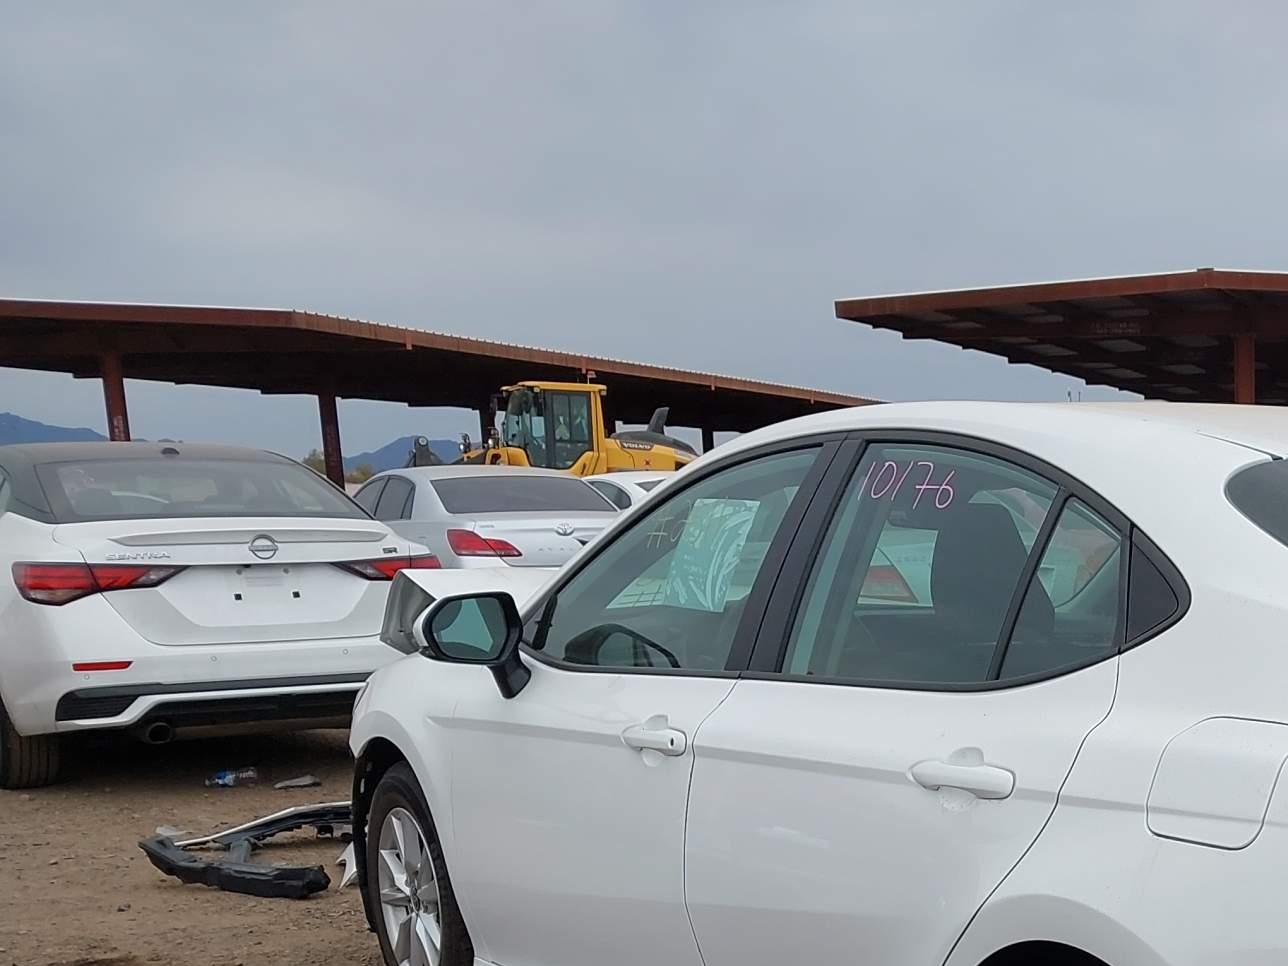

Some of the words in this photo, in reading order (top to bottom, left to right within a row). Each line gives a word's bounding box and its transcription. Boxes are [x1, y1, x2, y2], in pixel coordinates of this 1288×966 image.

[622, 442, 652, 450] VOLVO
[857, 460, 956, 511] 10176
[105, 551, 171, 561] SENTRA
